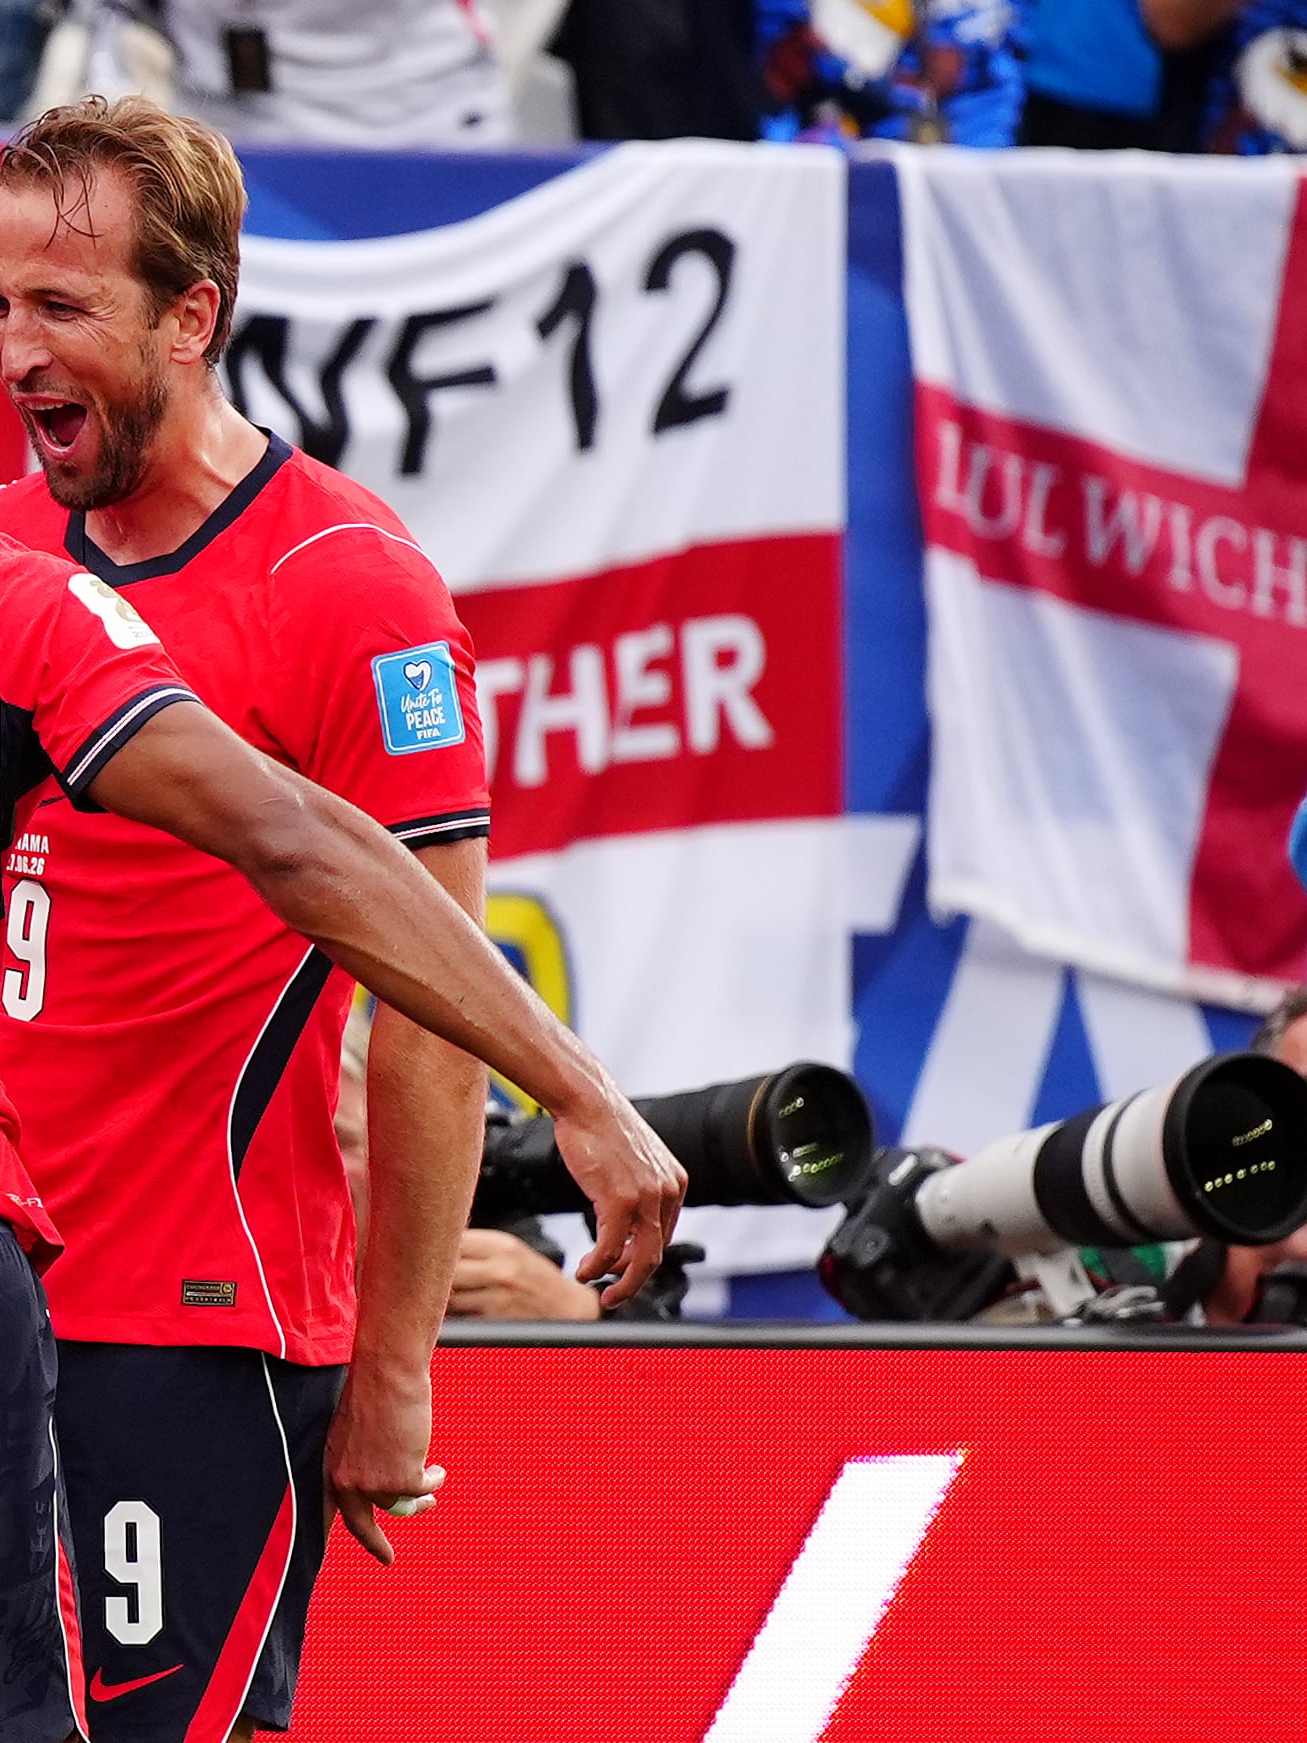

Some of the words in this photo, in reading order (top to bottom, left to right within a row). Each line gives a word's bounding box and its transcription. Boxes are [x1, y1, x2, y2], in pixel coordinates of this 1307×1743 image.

[405, 706, 446, 731] PEACE
[416, 727, 441, 740] FIFA
[5, 853, 46, 876] 7.06.26
[1, 878, 52, 1023] 9
[103, 1500, 164, 1646] 9
